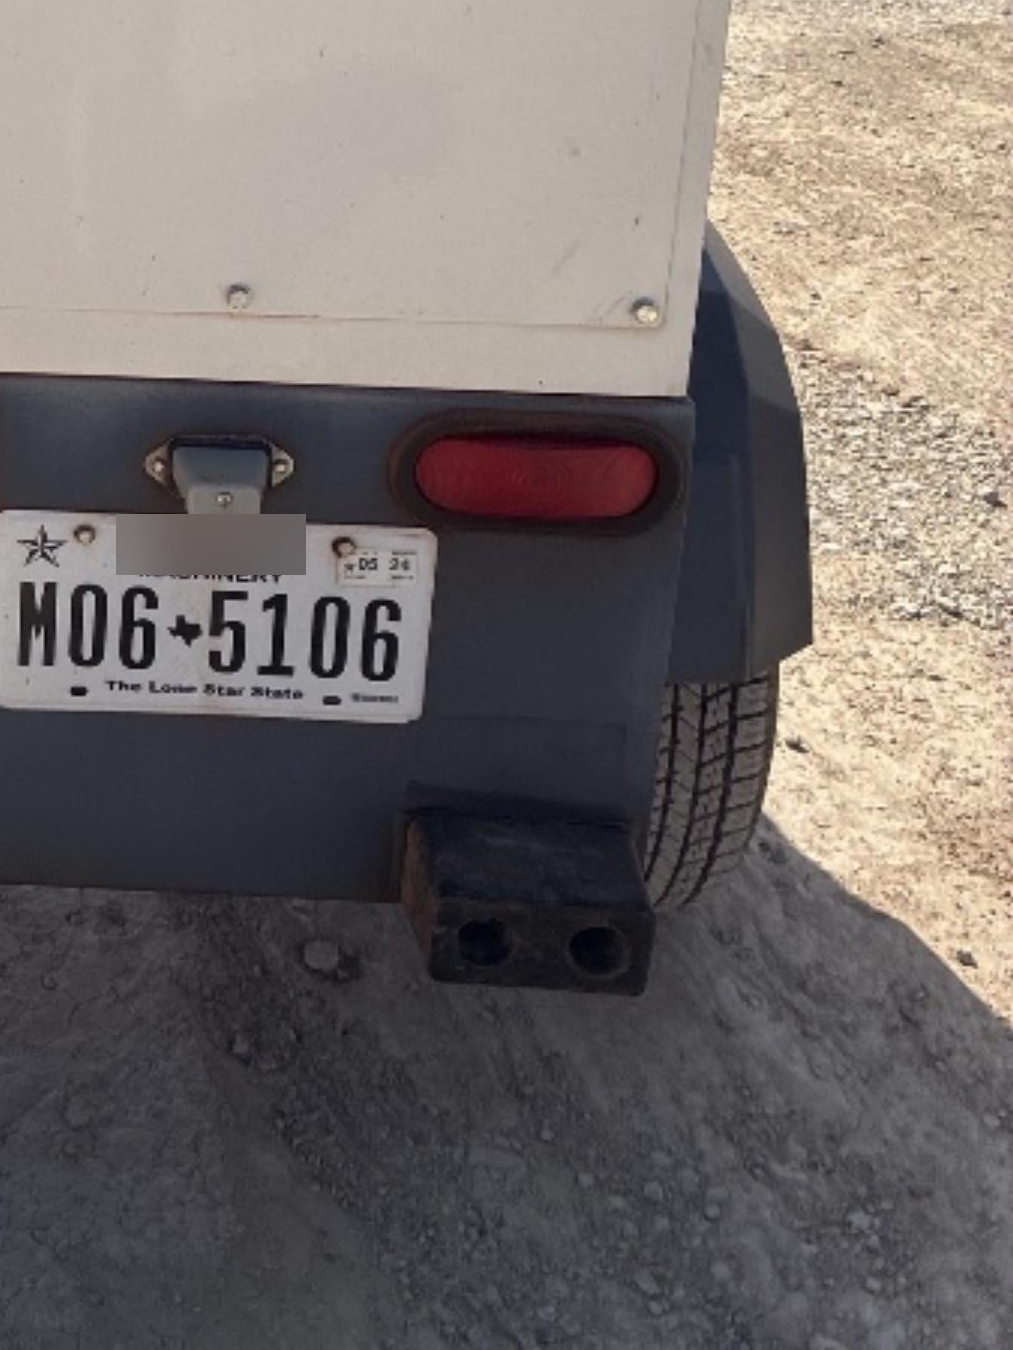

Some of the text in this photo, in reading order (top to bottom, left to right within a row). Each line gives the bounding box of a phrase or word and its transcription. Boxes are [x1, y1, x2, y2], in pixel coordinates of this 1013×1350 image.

[18, 581, 402, 683] M06 5106
[105, 680, 304, 700] The Lone Star State
